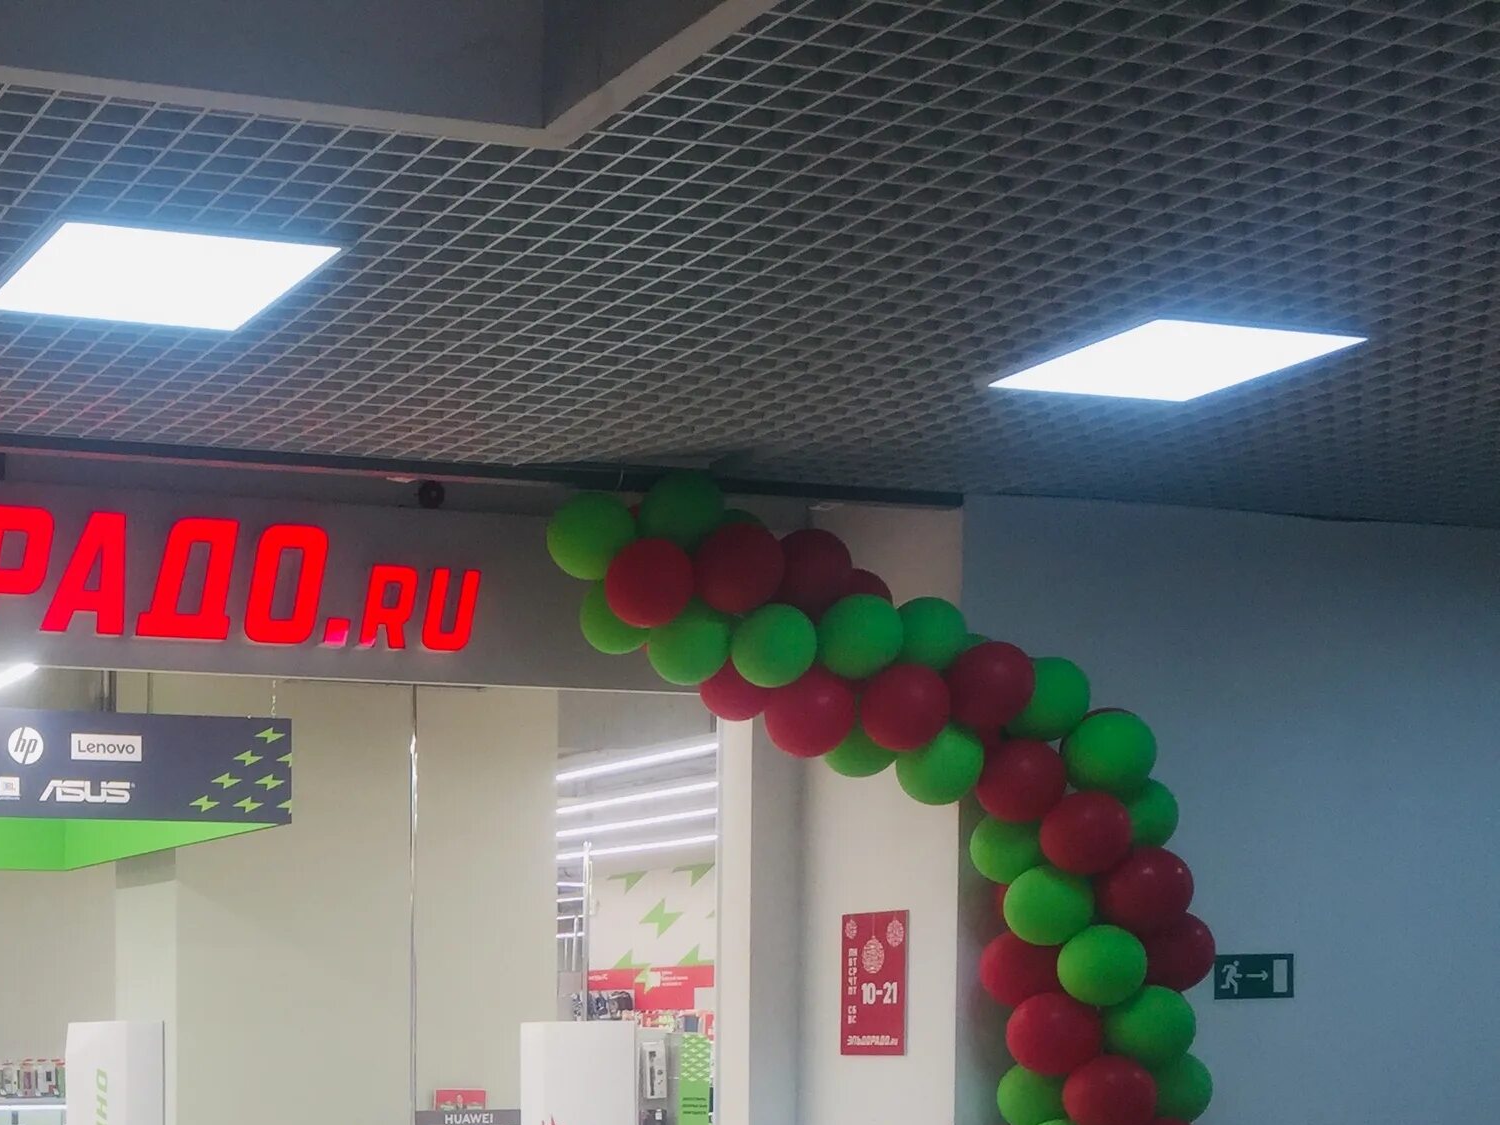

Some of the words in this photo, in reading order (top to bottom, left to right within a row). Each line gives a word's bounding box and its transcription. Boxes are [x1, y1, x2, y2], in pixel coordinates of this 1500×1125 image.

[77, 740, 136, 754] Lenovo
[39, 779, 131, 803] ASUS
[861, 982, 898, 1004] 10-21
[445, 1113, 494, 1125] HUAWEI
